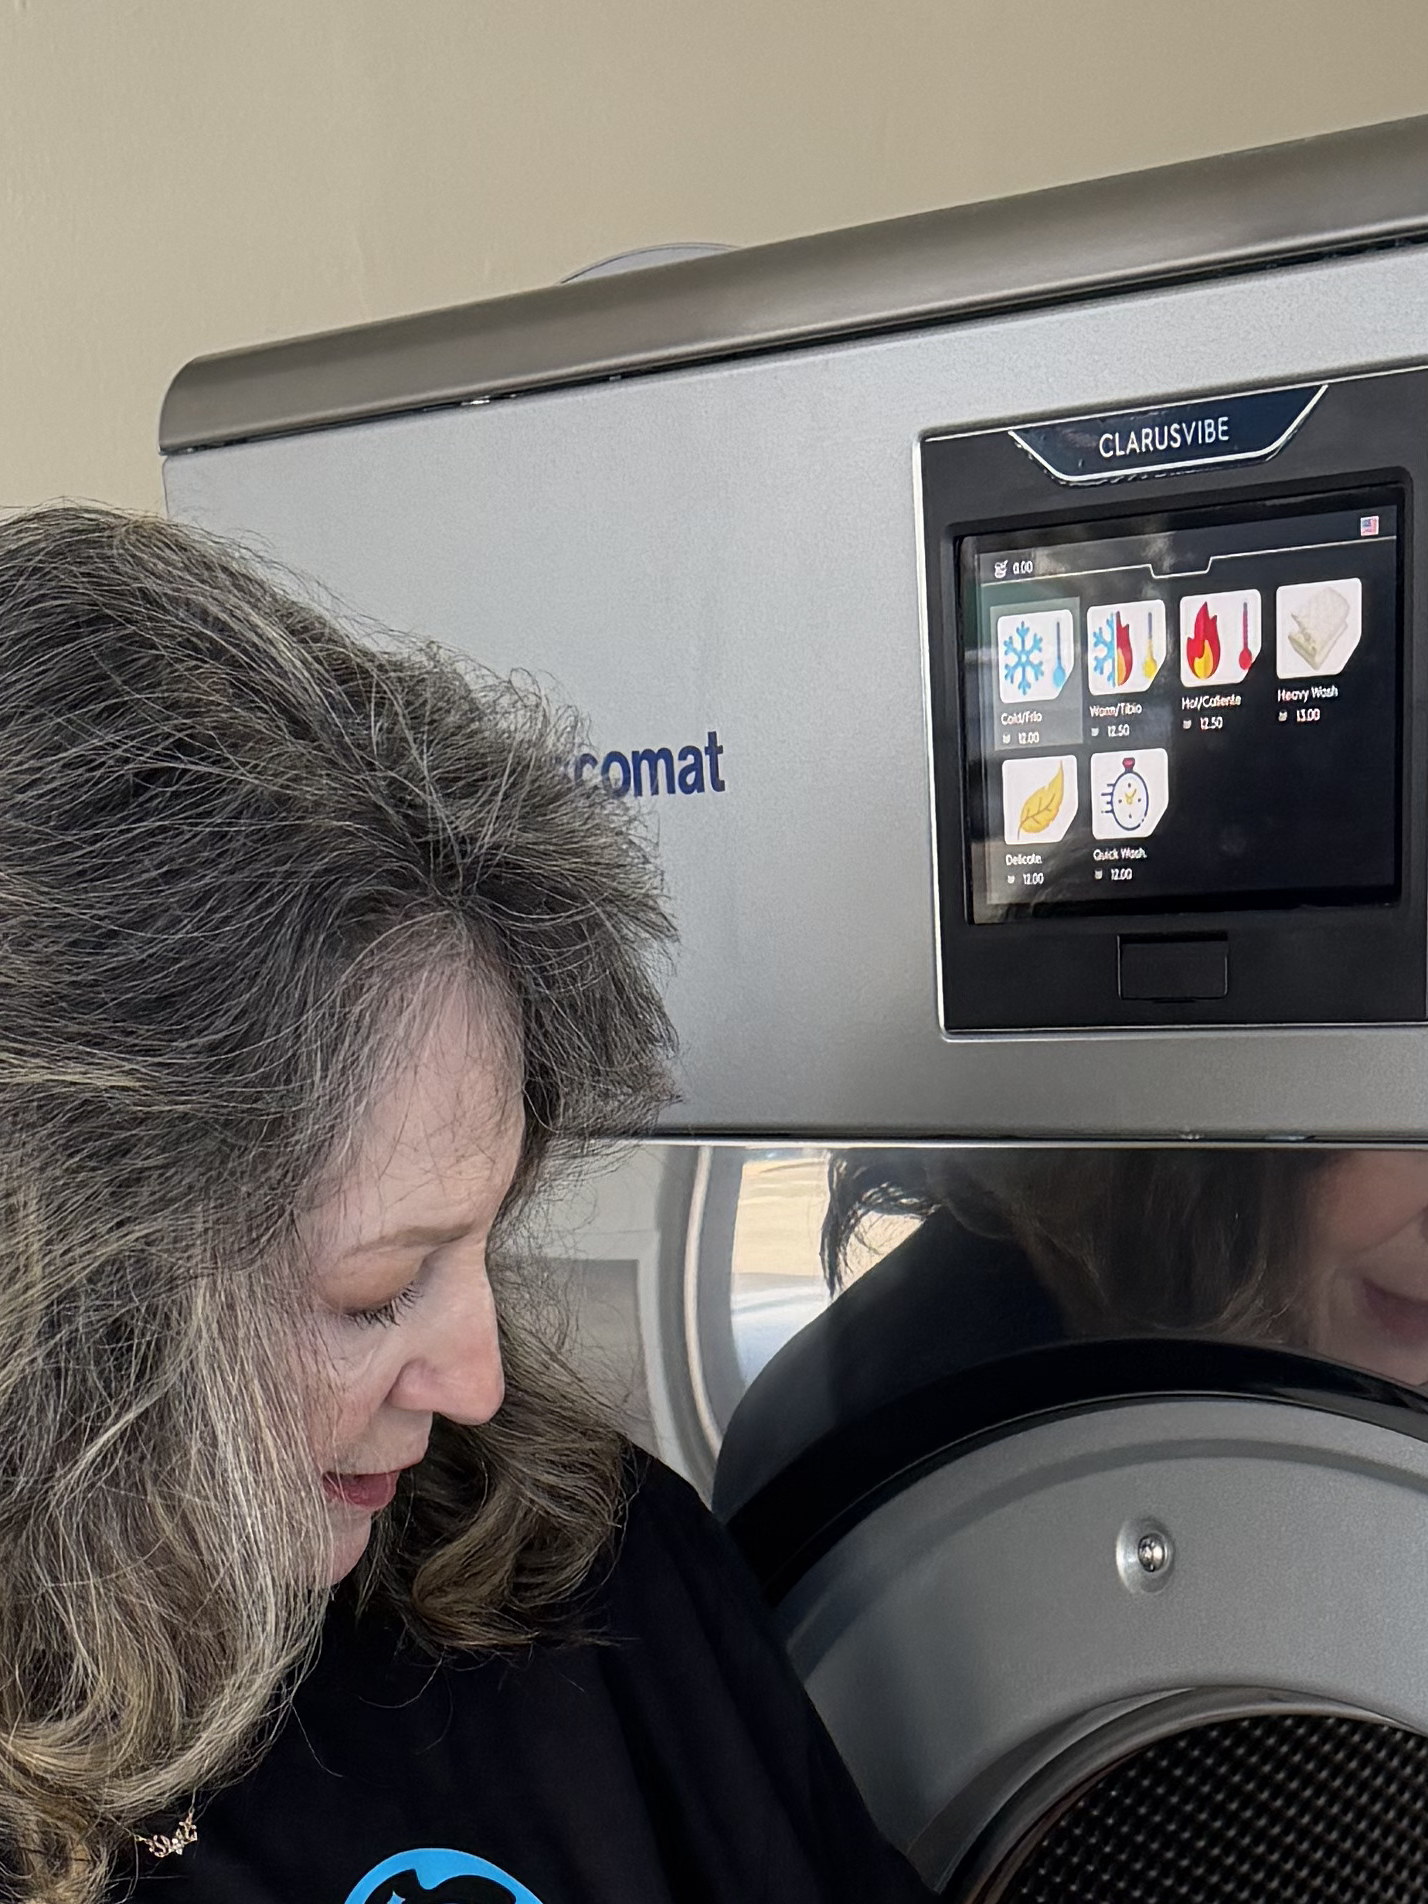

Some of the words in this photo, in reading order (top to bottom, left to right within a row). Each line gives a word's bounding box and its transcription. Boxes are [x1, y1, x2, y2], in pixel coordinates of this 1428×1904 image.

[1098, 415, 1231, 459] CLARUSVIBE
[1277, 688, 1309, 703] Heavy
[1310, 684, 1339, 699] Wash
[1092, 848, 1119, 862] Quick
